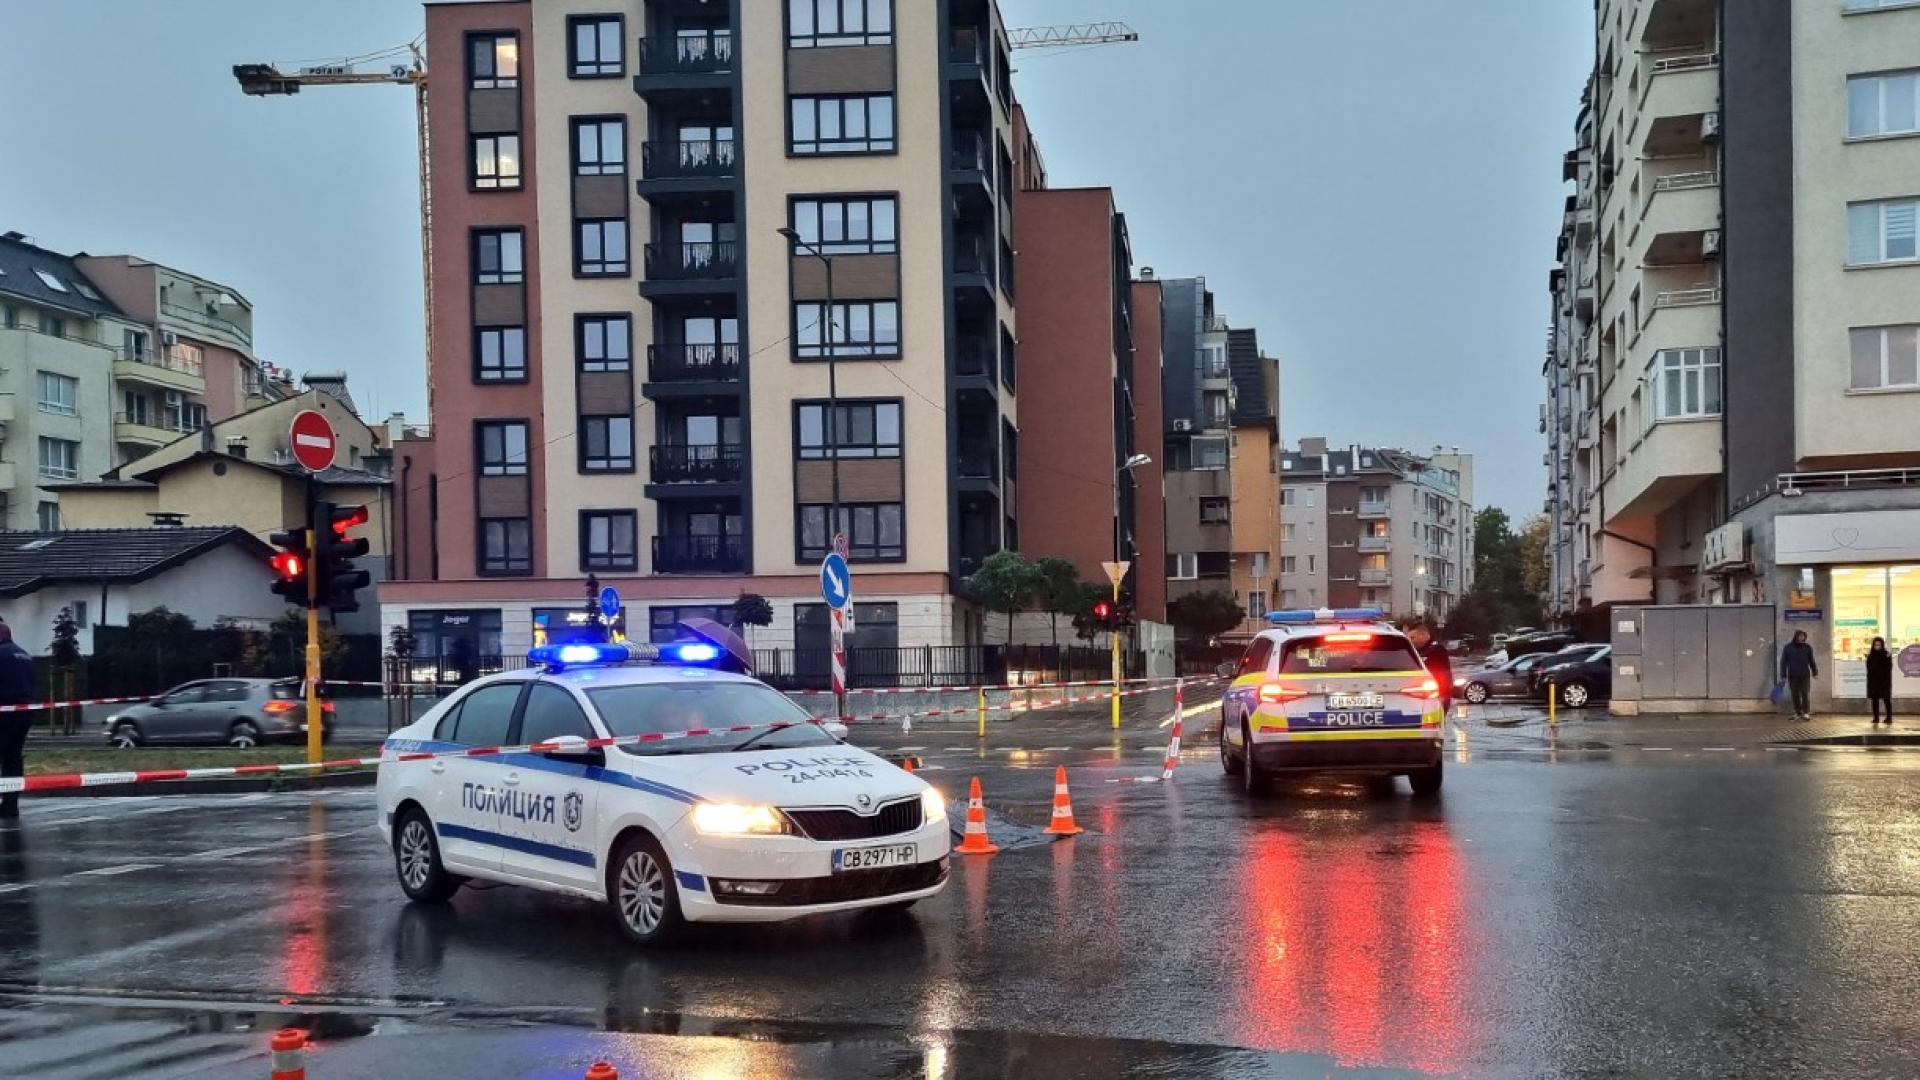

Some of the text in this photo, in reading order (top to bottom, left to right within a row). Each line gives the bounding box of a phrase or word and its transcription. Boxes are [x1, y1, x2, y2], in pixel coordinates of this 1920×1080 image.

[1327, 711, 1383, 726] POLICE
[735, 757, 873, 775] POLICE
[463, 782, 555, 824] ПОЛИЦИЯ
[843, 845, 914, 868] CB 2971 HP
